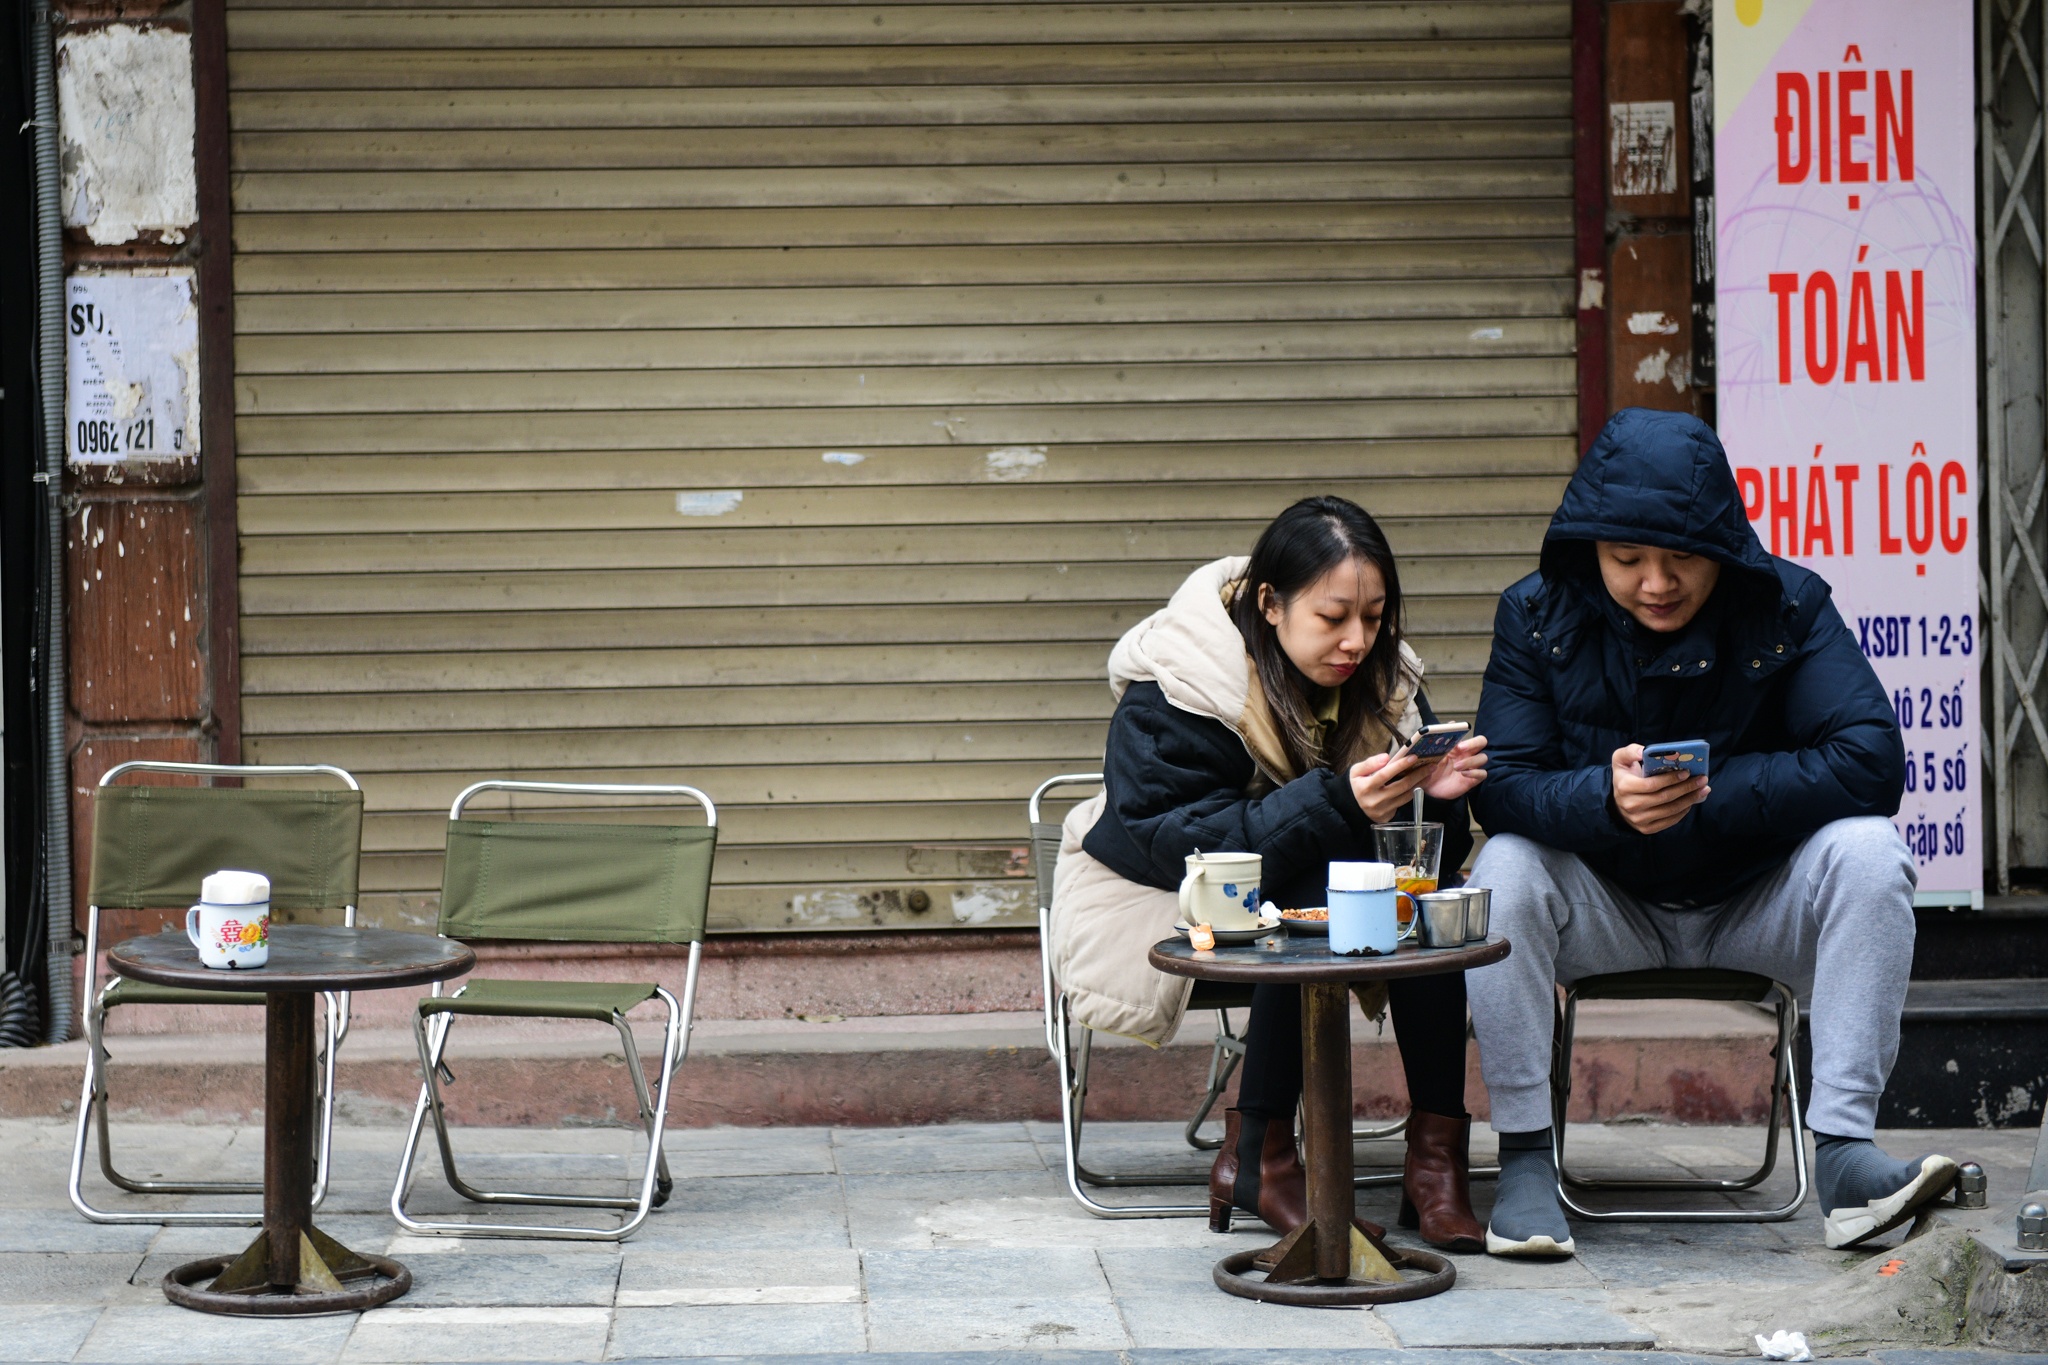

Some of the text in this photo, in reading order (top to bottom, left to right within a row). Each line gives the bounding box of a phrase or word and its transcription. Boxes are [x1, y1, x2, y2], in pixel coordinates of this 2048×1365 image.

[1774, 44, 1914, 210] ĐIỆN
[1768, 245, 1925, 385] TOÁN
[1736, 441, 1968, 577] PHÁT LỘC
[1858, 615, 1972, 658] XSĐT 1-2-3
[1921, 688, 1933, 728] 2
[1940, 679, 1964, 728] số
[1905, 743, 1968, 793] ô 5 số
[1906, 806, 1966, 867] cặp số
